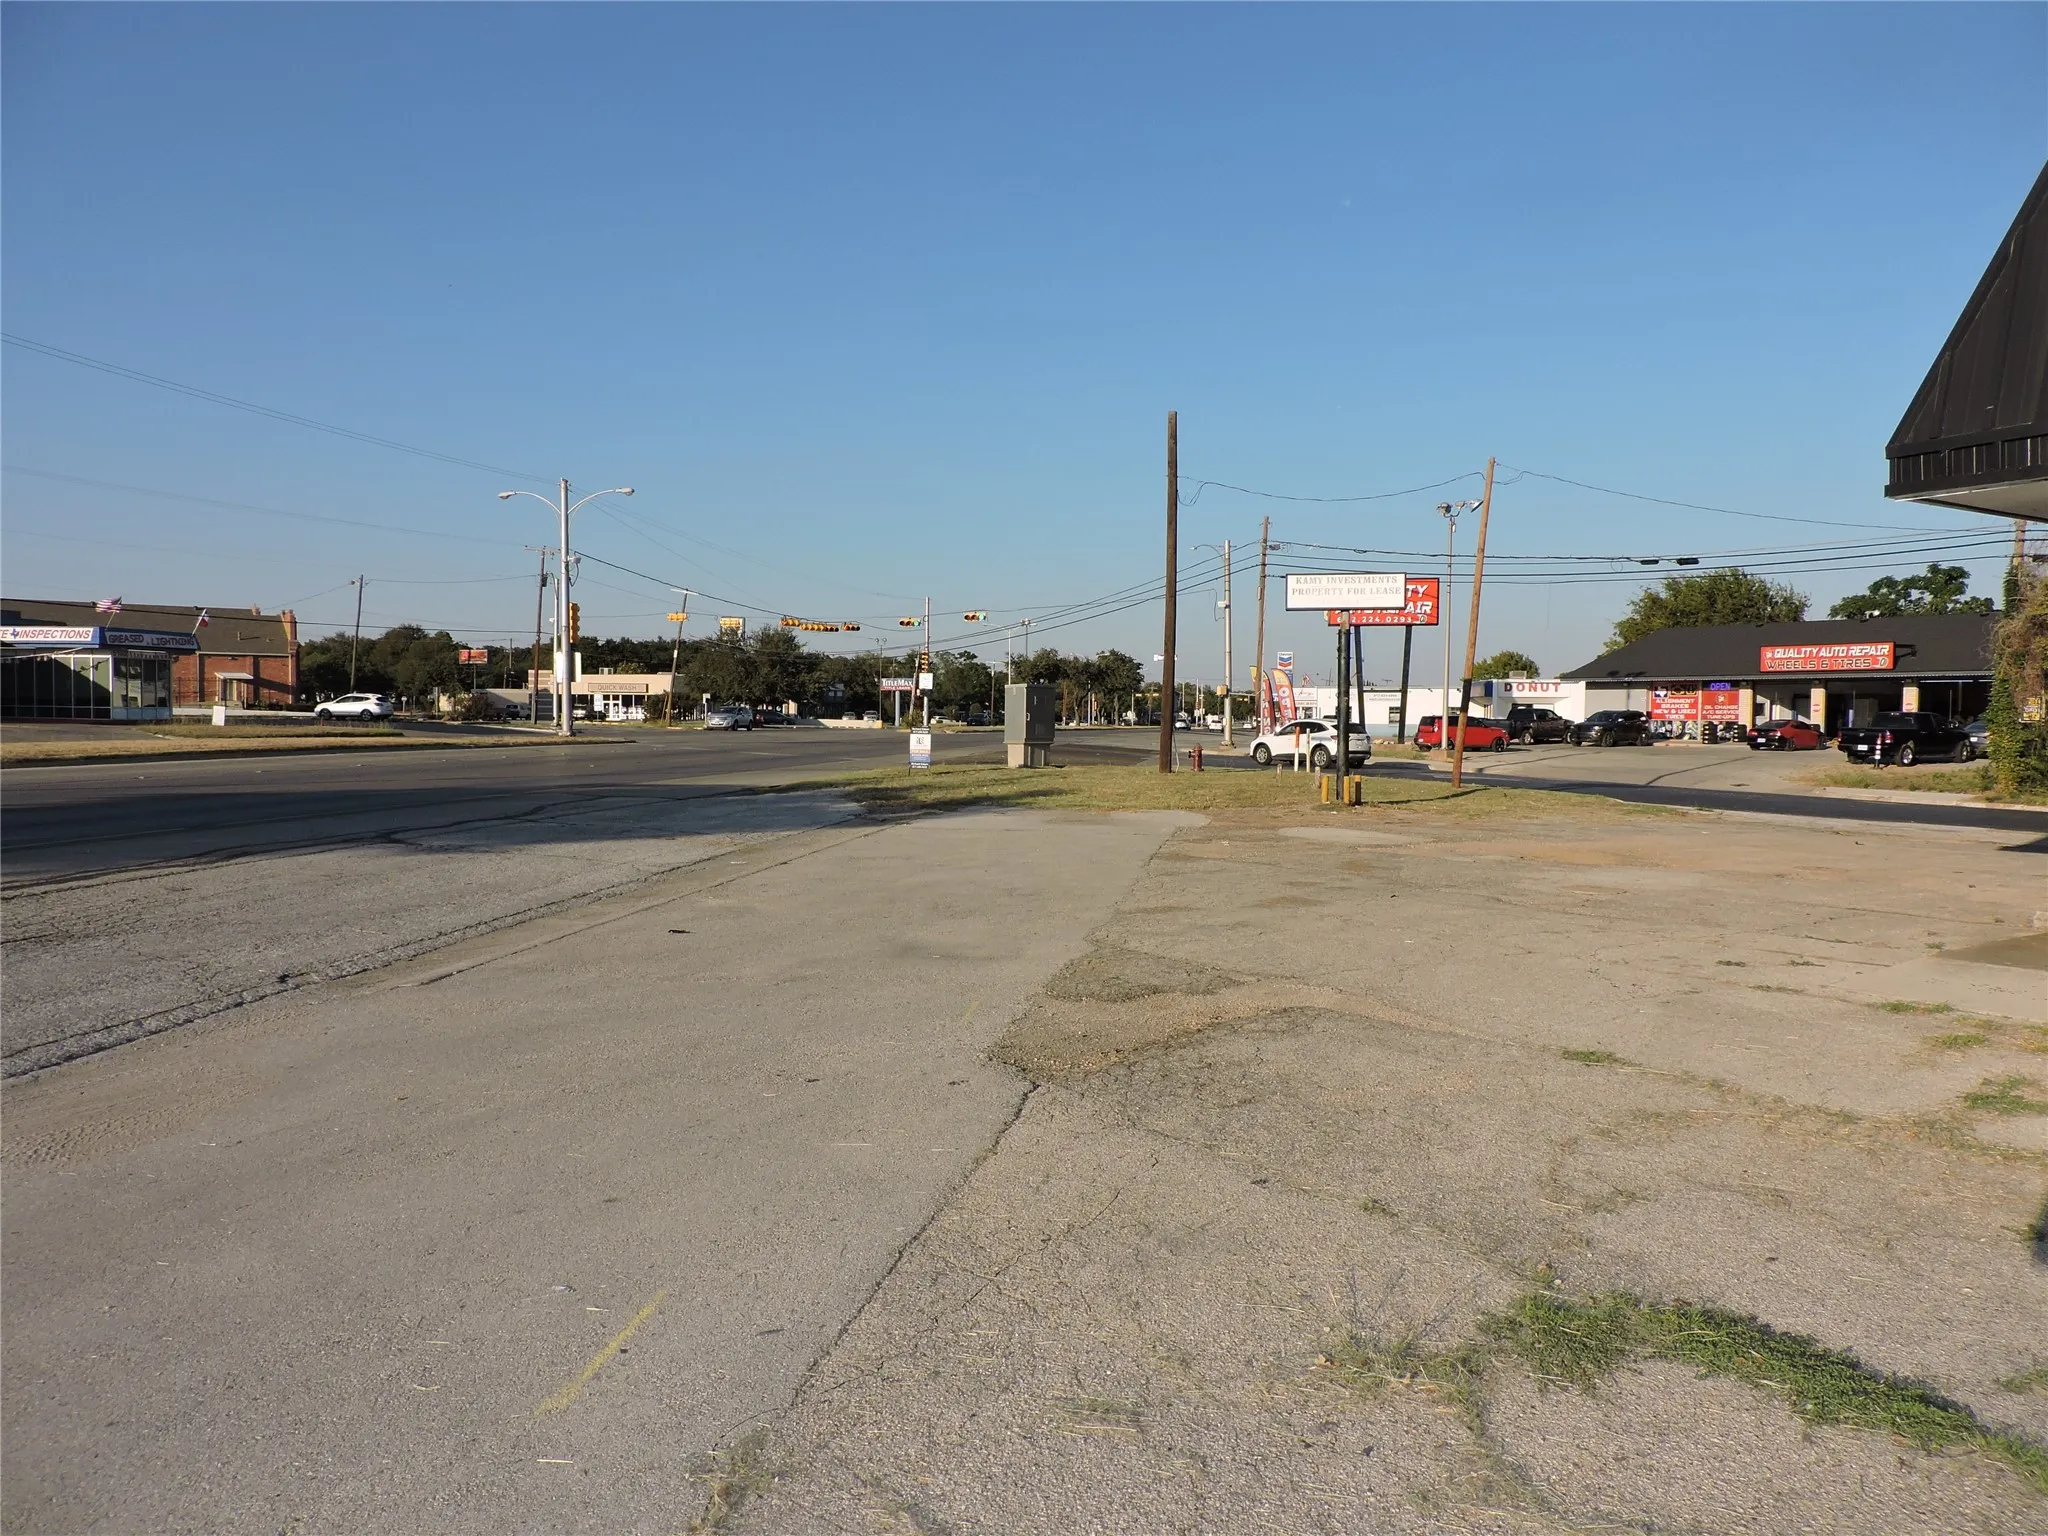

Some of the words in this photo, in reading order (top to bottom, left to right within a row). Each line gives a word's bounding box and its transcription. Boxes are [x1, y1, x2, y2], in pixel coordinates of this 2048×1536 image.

[1326, 576, 1398, 584] INVESTMENTS
[1292, 587, 1343, 596] PROPERTY
[1347, 587, 1366, 595] FOR
[1370, 586, 1402, 595] LEASE
[19, 629, 92, 639] INSPECTIONS
[108, 634, 145, 643] GREASED
[1774, 648, 1818, 658] QUALITY
[1818, 646, 1847, 657] AUTO
[1848, 645, 1889, 656] REPAIR
[1766, 660, 1816, 670] WHEELS
[1833, 659, 1871, 668] TIRES
[1504, 682, 1560, 692] DONUT
[1710, 682, 1731, 690] OPEN
